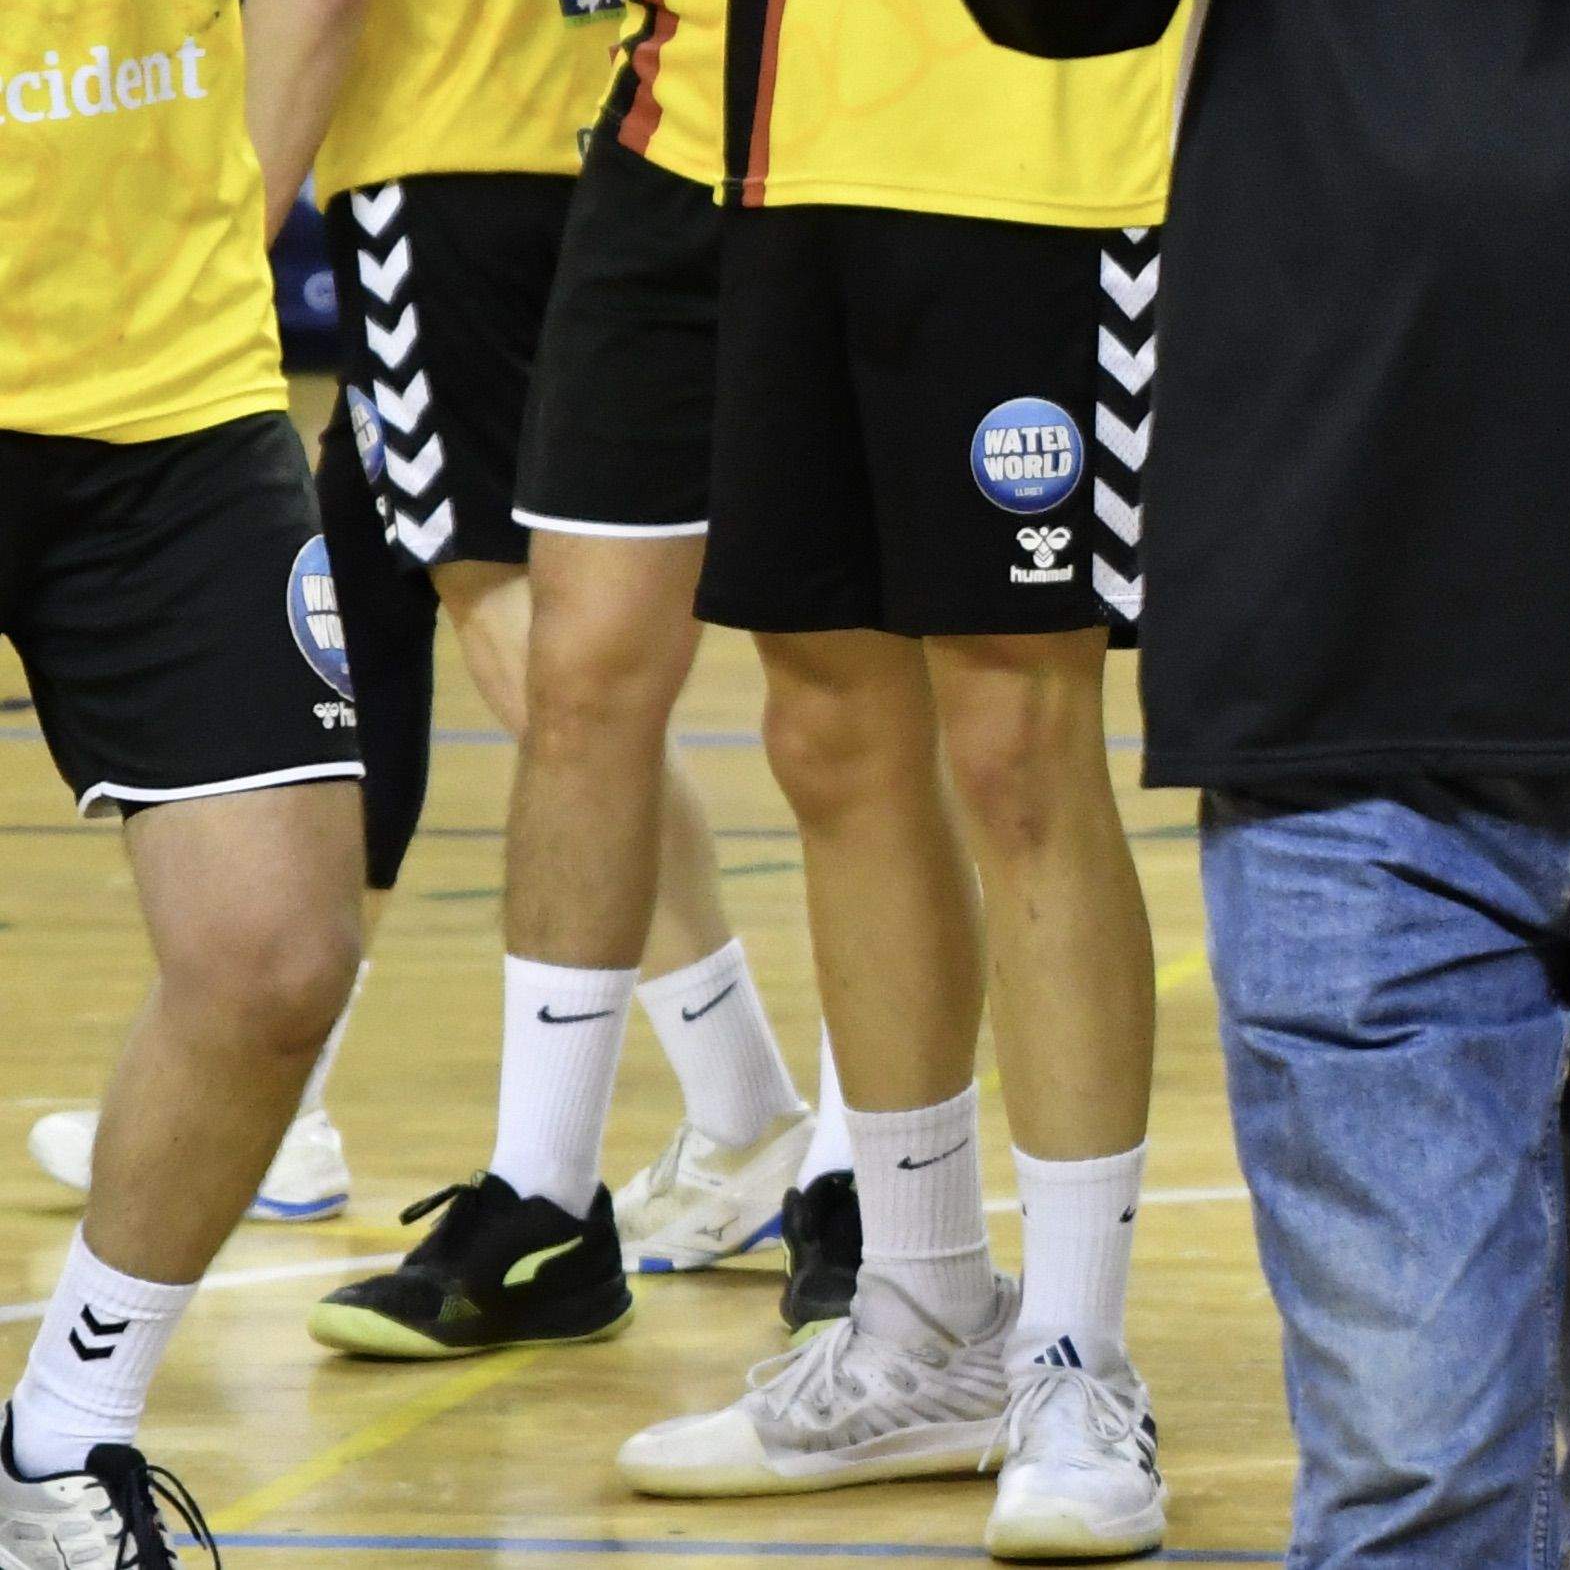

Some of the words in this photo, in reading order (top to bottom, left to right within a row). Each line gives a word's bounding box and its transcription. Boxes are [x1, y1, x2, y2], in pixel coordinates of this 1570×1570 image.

[984, 425, 1072, 456] WATER
[983, 451, 1073, 482] WORLD
[1010, 563, 1074, 583] hummel
